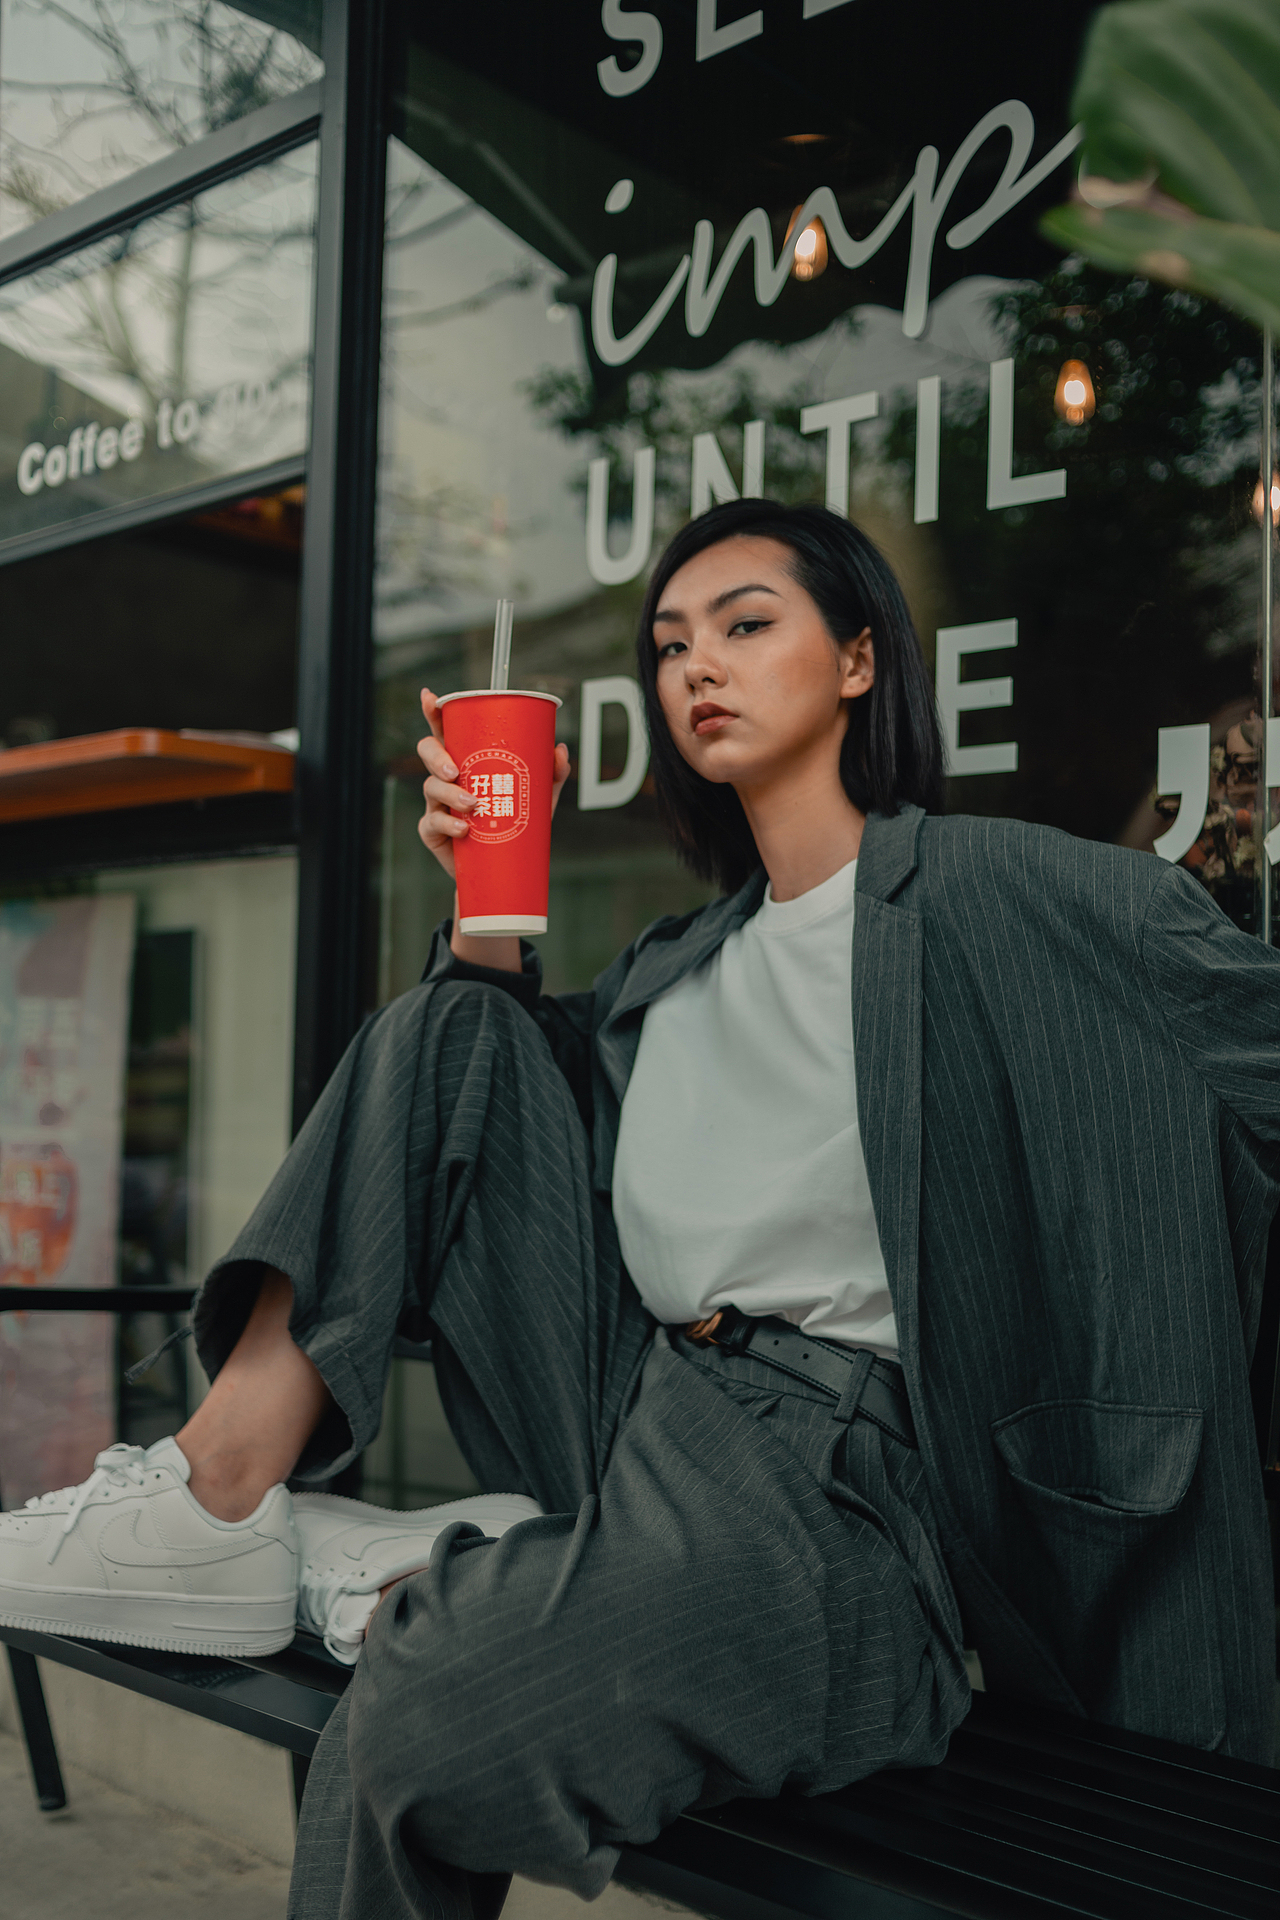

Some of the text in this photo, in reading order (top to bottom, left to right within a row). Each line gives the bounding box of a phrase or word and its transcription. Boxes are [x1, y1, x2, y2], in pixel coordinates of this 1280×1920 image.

[17, 417, 145, 496] Coffee
[155, 398, 201, 449] to
[585, 357, 1068, 586] UNTIL
